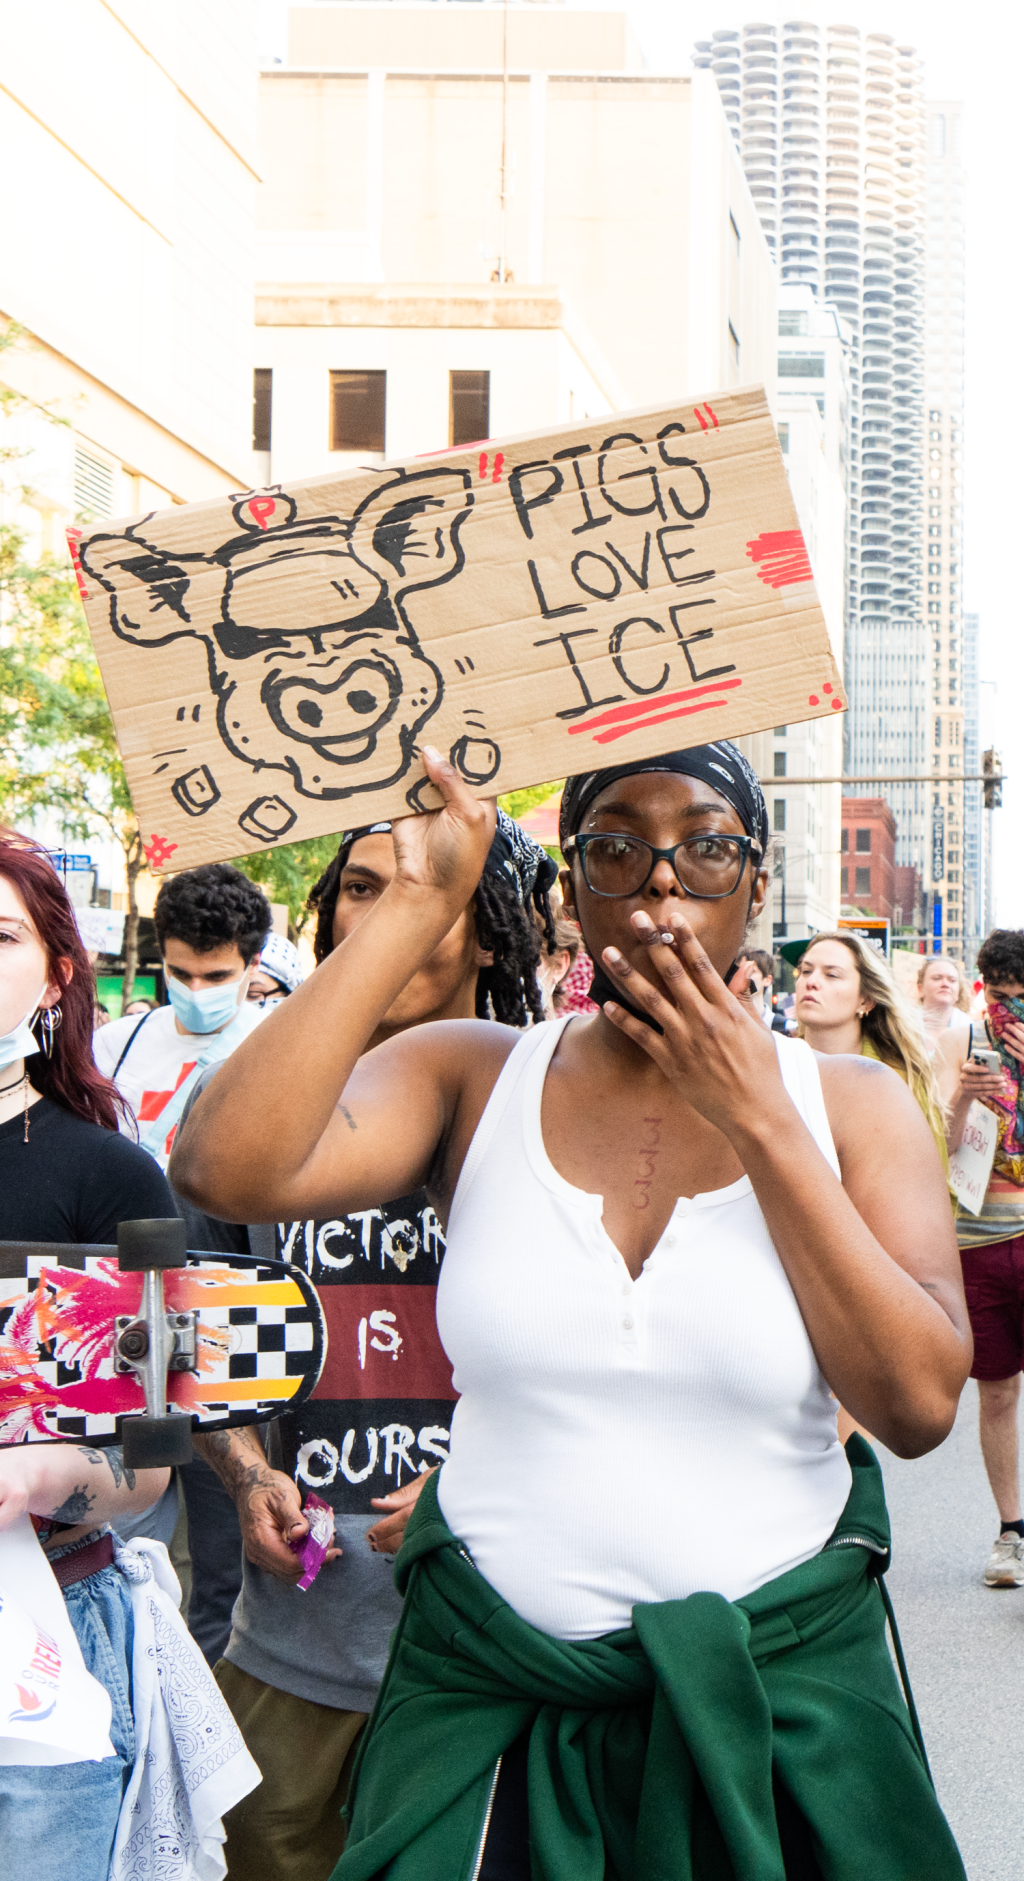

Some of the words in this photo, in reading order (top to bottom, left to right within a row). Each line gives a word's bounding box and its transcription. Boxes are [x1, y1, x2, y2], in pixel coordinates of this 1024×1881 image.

[248, 497, 276, 531] P
[527, 524, 716, 620] LOVE
[533, 599, 737, 720] ICE
[934, 822, 943, 878] CHICAGO
[278, 1207, 447, 1277] VICTOR
[358, 1309, 403, 1370] IS
[294, 1423, 450, 1488] OURS
